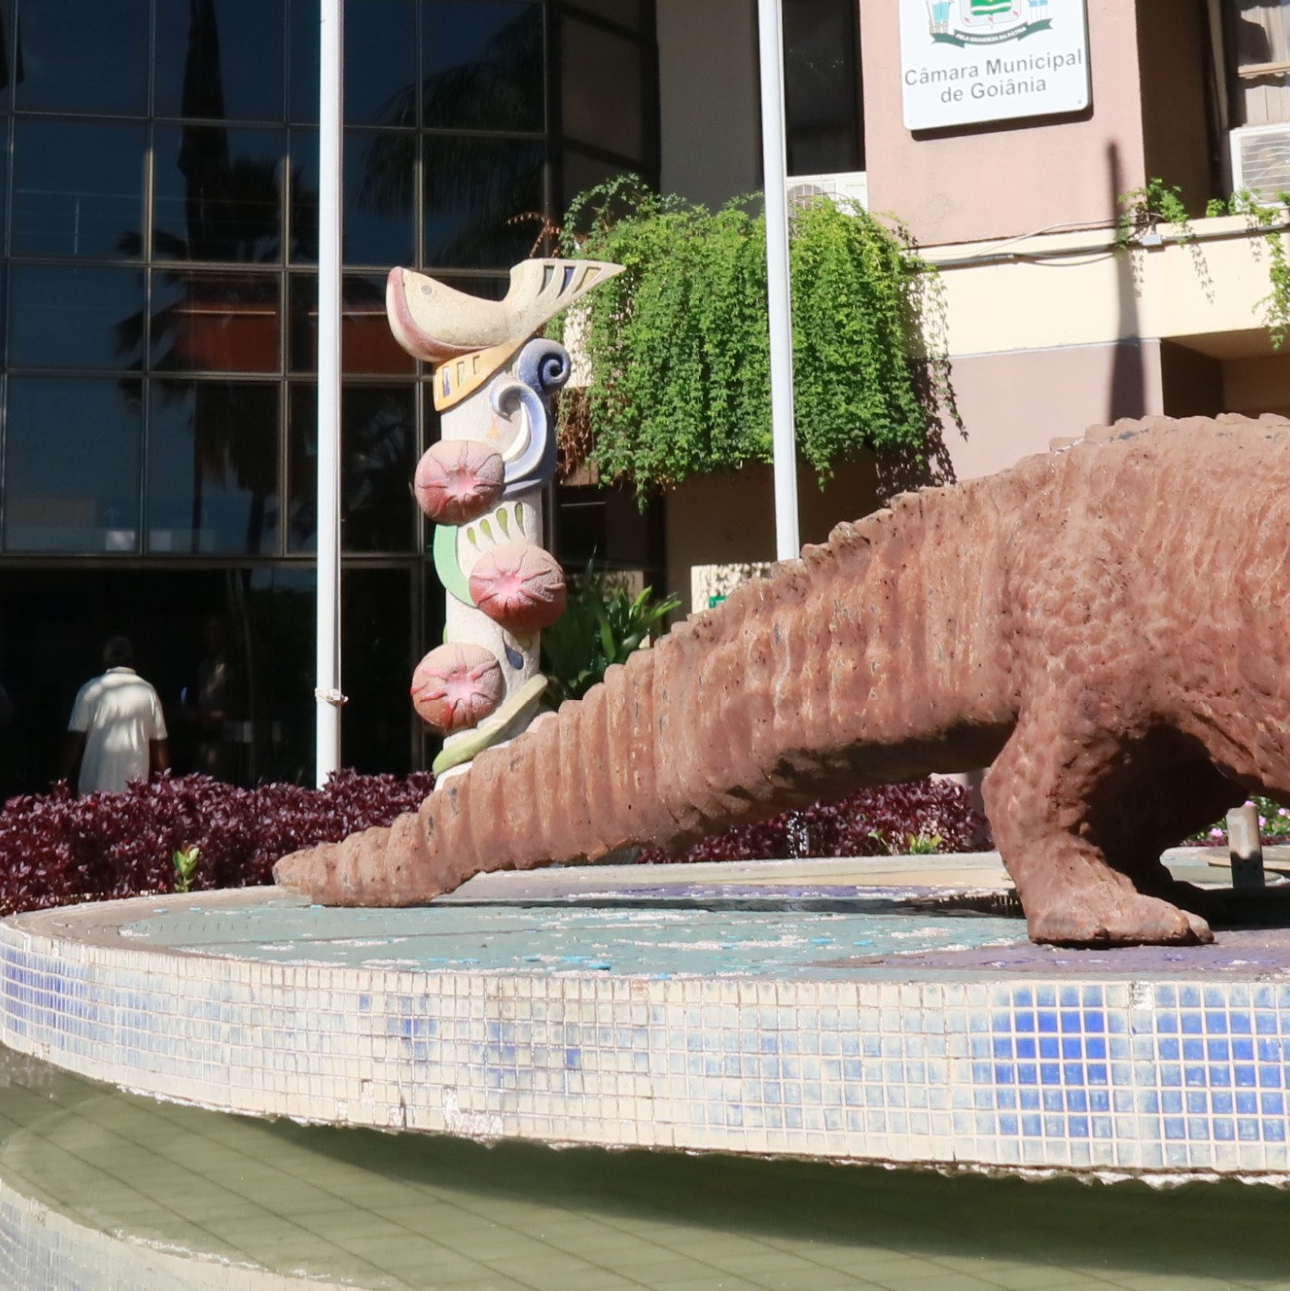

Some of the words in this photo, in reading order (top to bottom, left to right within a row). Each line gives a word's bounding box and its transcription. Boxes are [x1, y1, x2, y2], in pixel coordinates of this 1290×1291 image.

[904, 64, 979, 86] Câmara
[986, 48, 1082, 72] Municipal
[940, 87, 964, 103] de
[970, 76, 1047, 99] Goiânia
